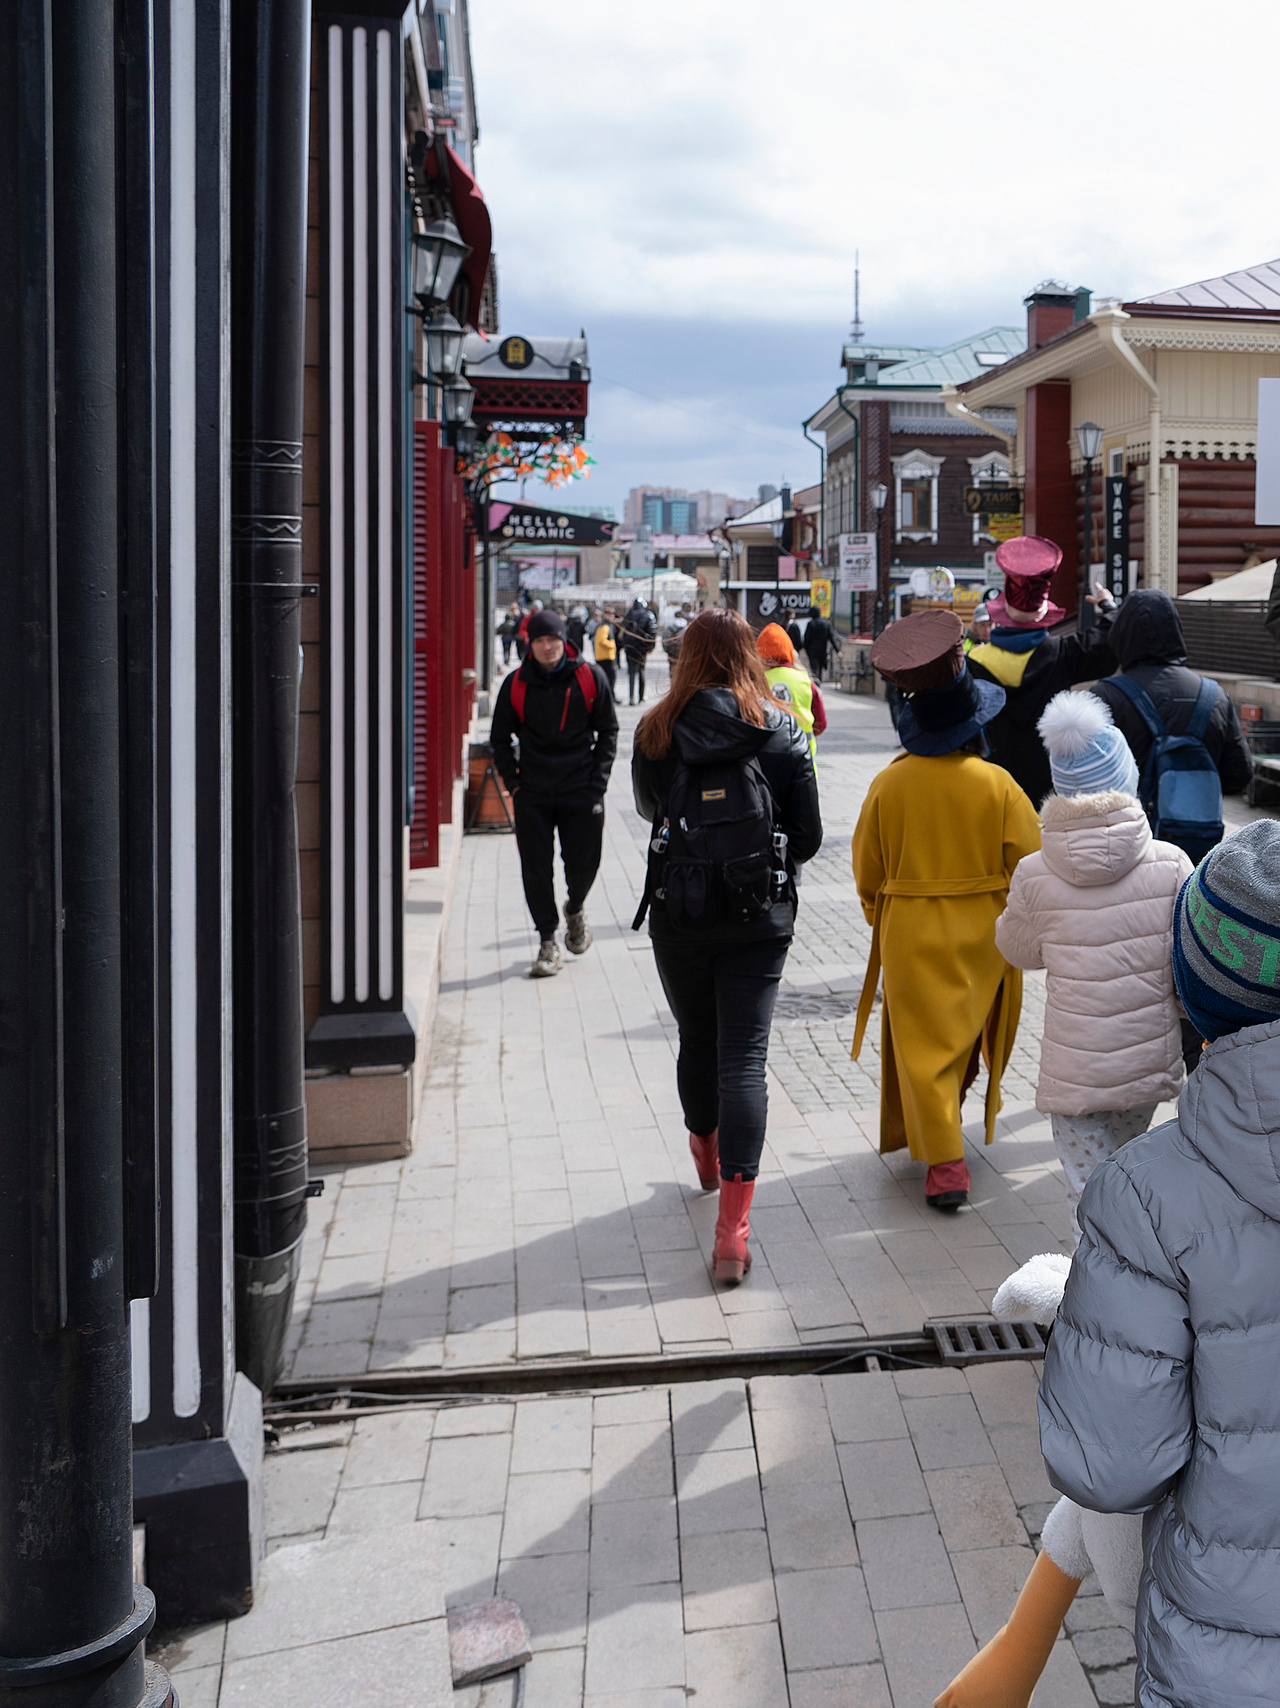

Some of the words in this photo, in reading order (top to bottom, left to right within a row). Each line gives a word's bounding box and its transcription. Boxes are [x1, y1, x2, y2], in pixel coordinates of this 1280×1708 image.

[1112, 482, 1123, 539] VAPE
[509, 515, 570, 528] HELLO
[502, 525, 575, 539] ORGANIC
